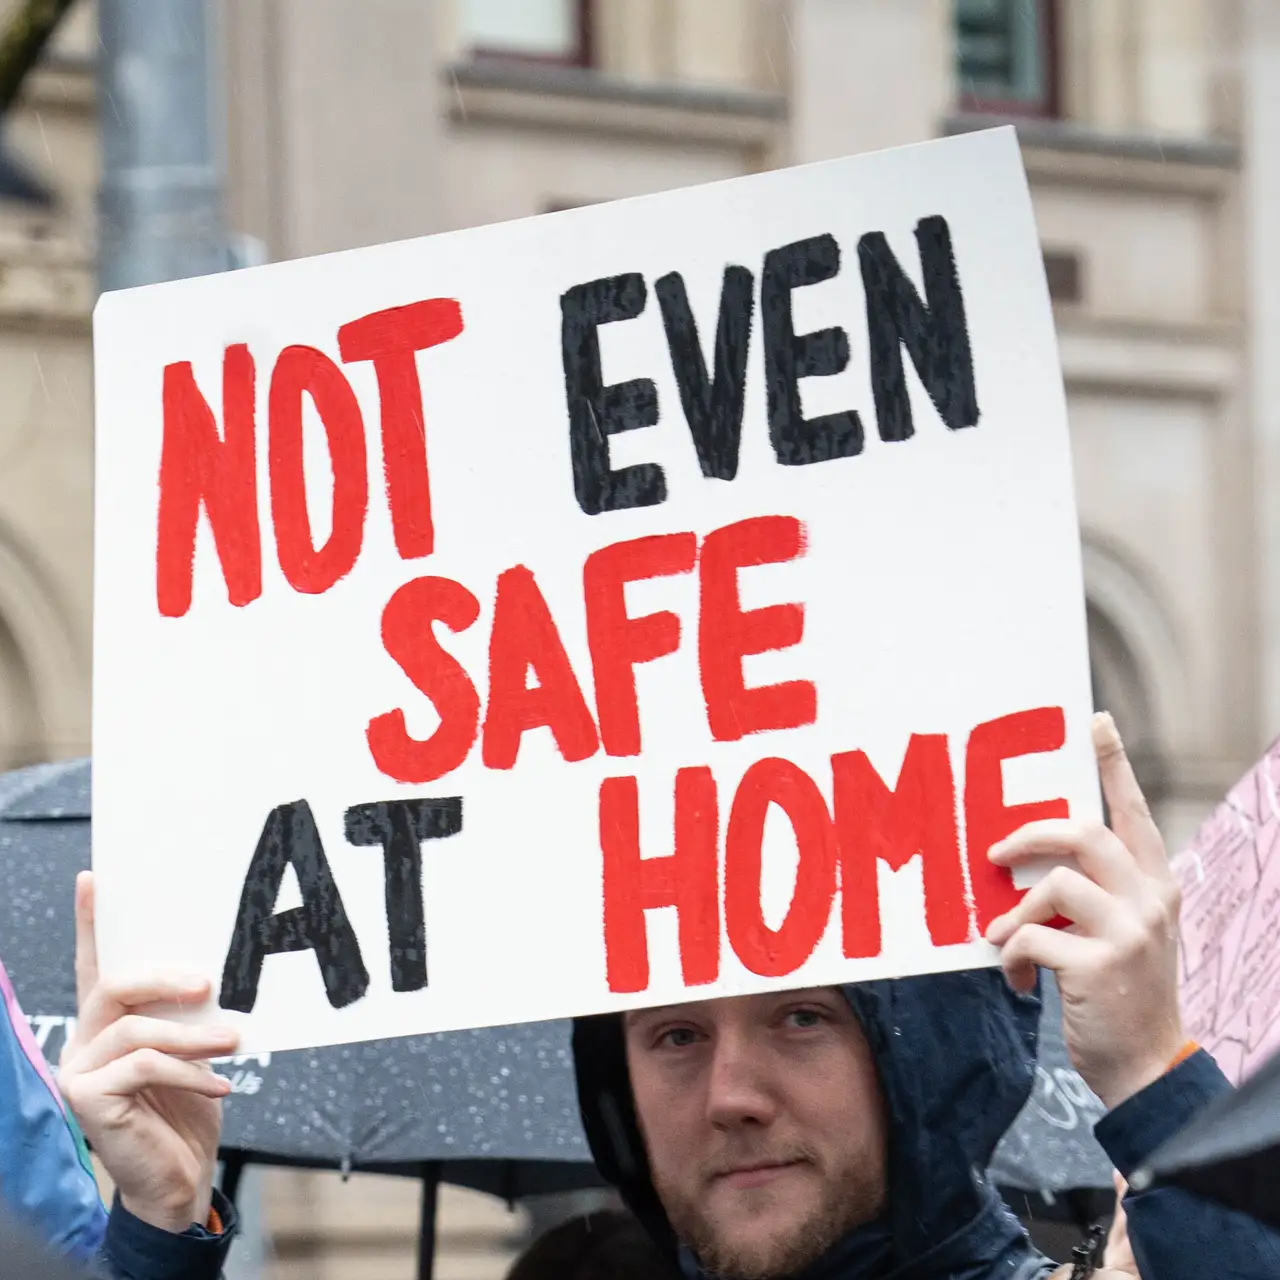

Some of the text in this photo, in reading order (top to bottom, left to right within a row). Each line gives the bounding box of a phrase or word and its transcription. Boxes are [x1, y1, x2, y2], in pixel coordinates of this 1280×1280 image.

[157, 215, 980, 618] NOT EVEN
[366, 515, 818, 784] SAFE
[218, 797, 463, 1014] AT
[599, 706, 1071, 993] HOME
